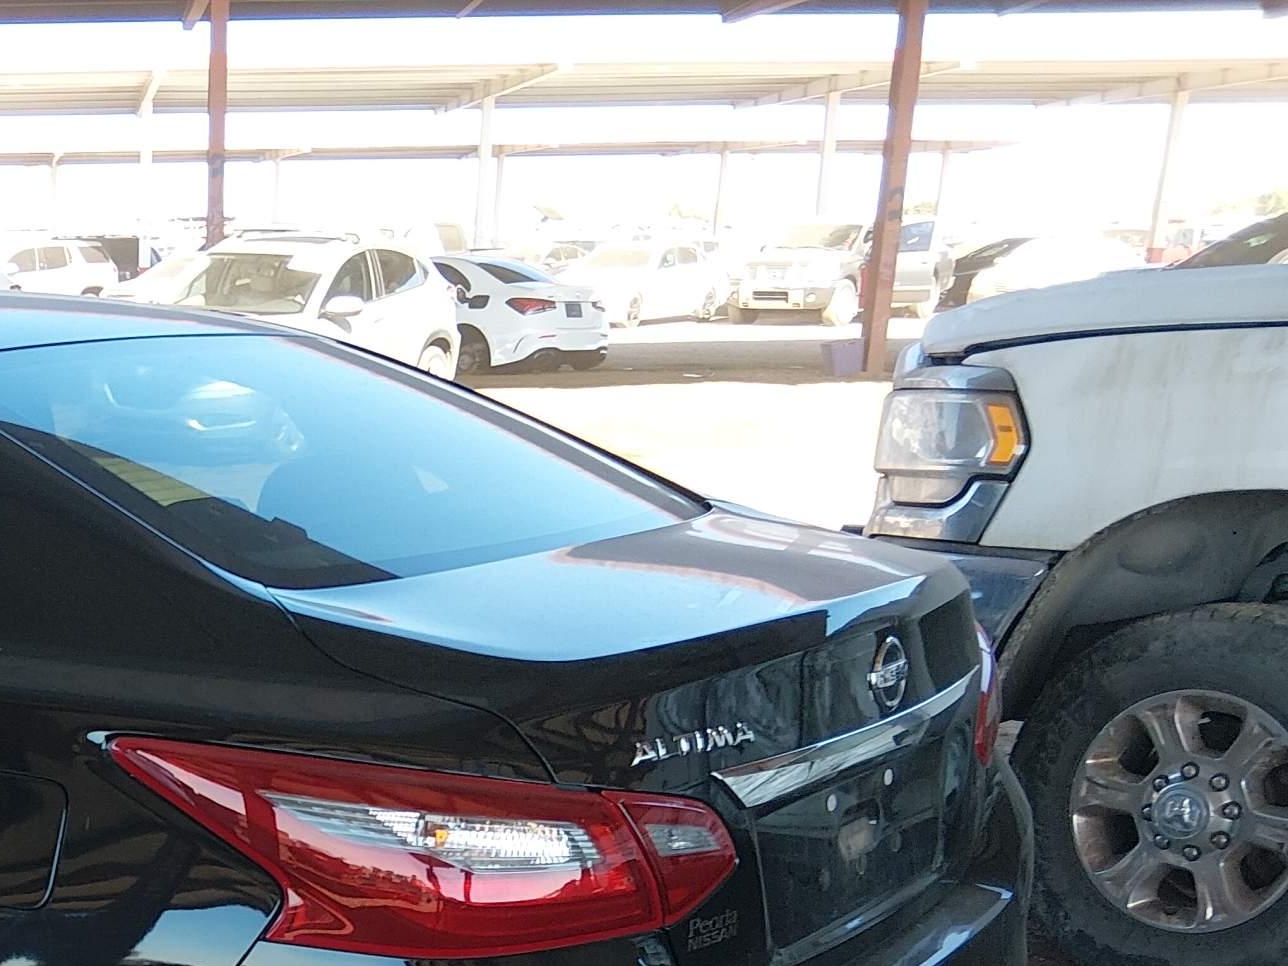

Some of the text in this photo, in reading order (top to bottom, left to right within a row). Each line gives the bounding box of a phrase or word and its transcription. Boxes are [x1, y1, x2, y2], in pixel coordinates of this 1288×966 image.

[630, 721, 756, 767] ALTIMA
[687, 924, 737, 952] NISSAN
[688, 908, 738, 938] Peoria
